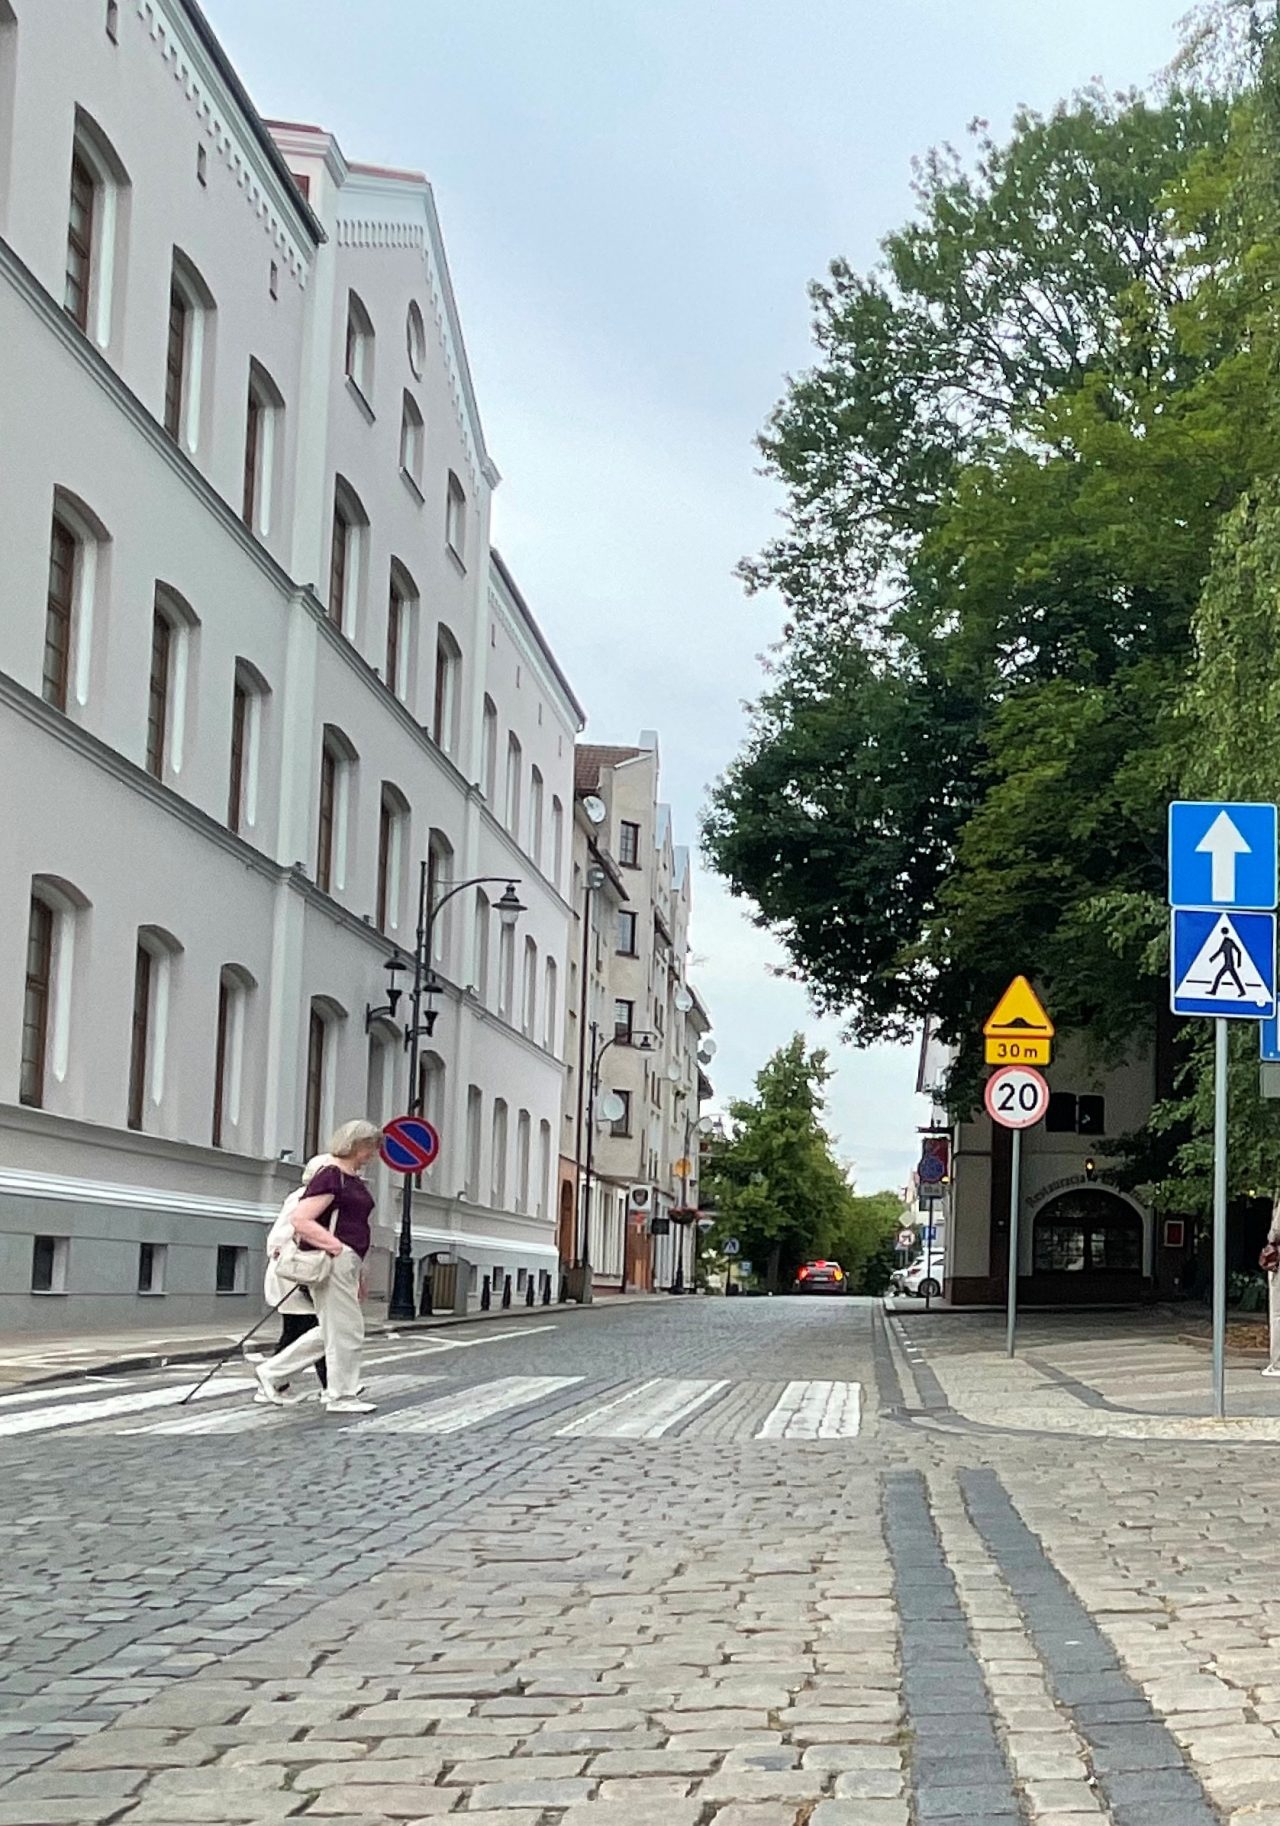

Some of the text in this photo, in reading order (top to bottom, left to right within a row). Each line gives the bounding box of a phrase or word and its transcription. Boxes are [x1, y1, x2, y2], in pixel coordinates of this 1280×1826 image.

[997, 1043, 1038, 1059] 30 m
[997, 1082, 1039, 1112] 20
